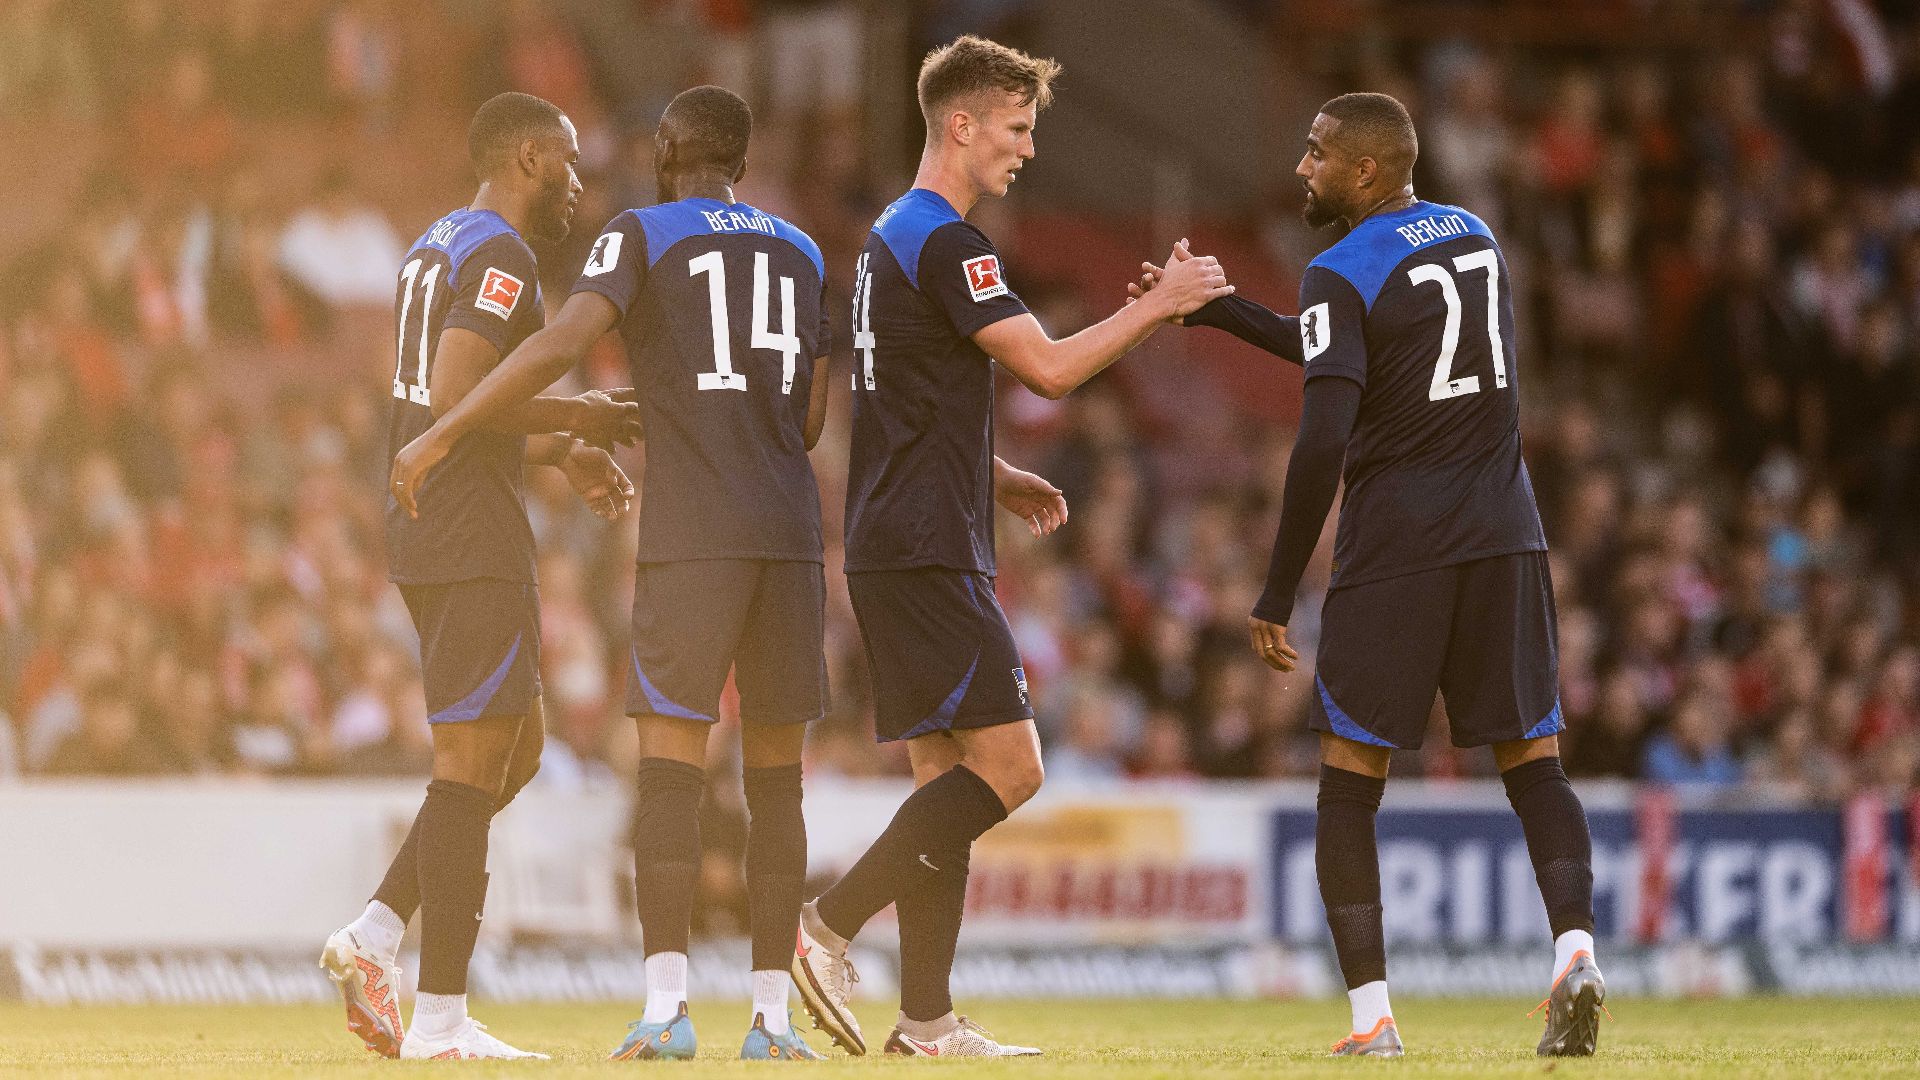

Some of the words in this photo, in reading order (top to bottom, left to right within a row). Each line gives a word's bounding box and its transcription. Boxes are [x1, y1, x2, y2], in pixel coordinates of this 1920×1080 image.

[393, 259, 441, 406] 11
[688, 251, 800, 395] 14
[852, 252, 876, 391] 4
[1407, 248, 1507, 402] 27
